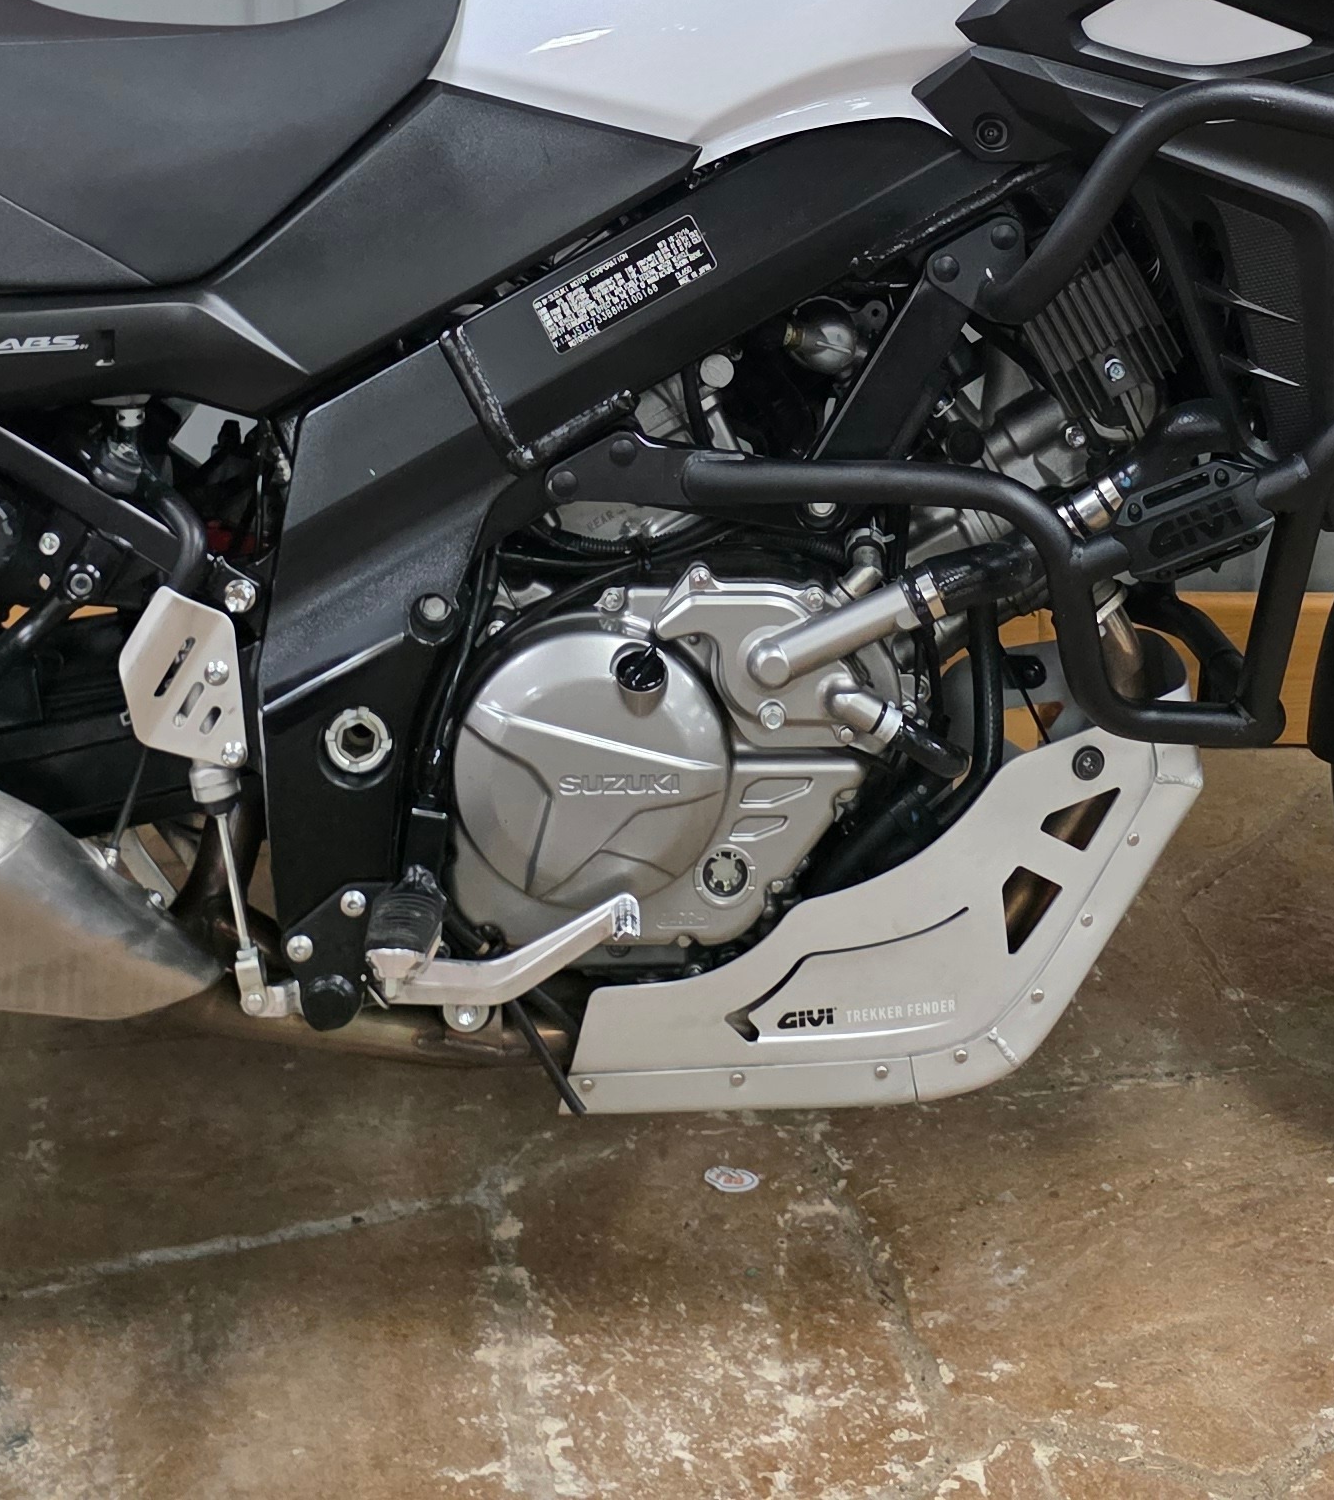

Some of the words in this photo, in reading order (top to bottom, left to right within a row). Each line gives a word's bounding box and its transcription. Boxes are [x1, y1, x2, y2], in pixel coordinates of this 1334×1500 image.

[559, 773, 680, 796] SUZUKI
[777, 1007, 836, 1029] GIVI
[846, 1005, 903, 1023] TREKKER
[907, 999, 956, 1017] FENDER
